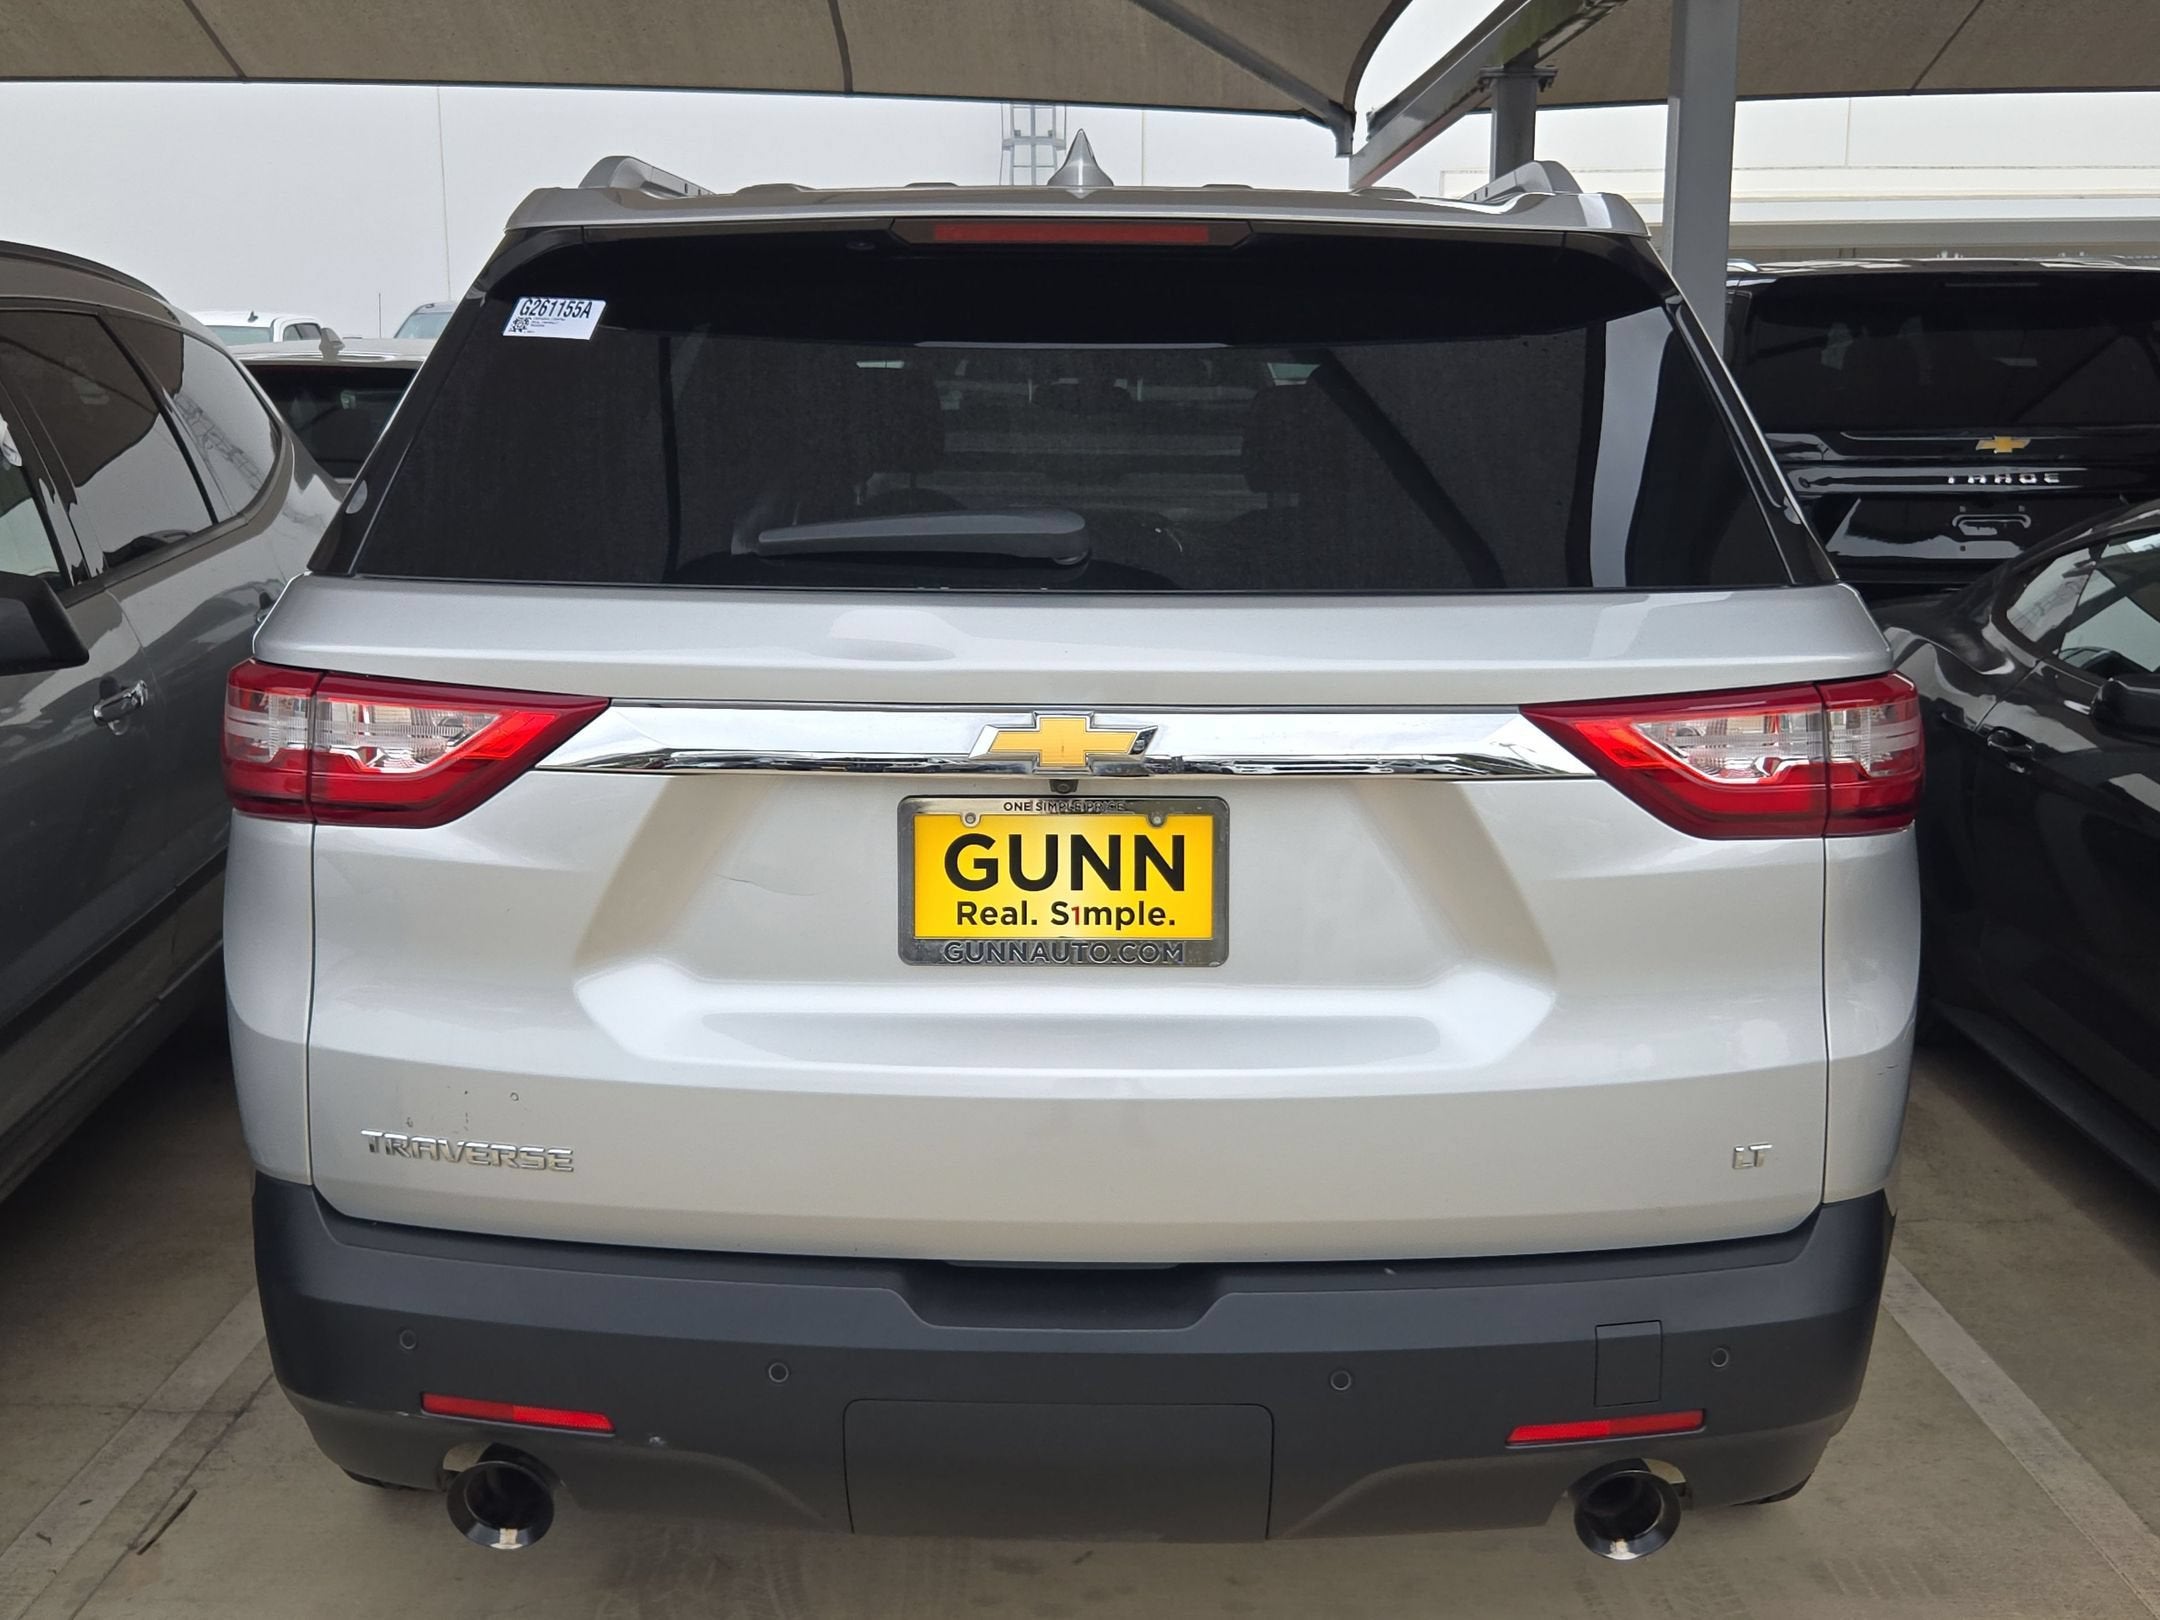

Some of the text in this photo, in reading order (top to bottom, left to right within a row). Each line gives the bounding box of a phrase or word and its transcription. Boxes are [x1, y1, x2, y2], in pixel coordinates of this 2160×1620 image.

[519, 299, 593, 319] G261155A
[1003, 801, 1032, 812] ONE
[944, 833, 1185, 892] GUNN
[956, 901, 1038, 926] Real.
[943, 942, 1185, 965] GUNNAUTO.COM
[360, 1129, 574, 1172] TRAVERSE
[1732, 1144, 1773, 1169] LT
